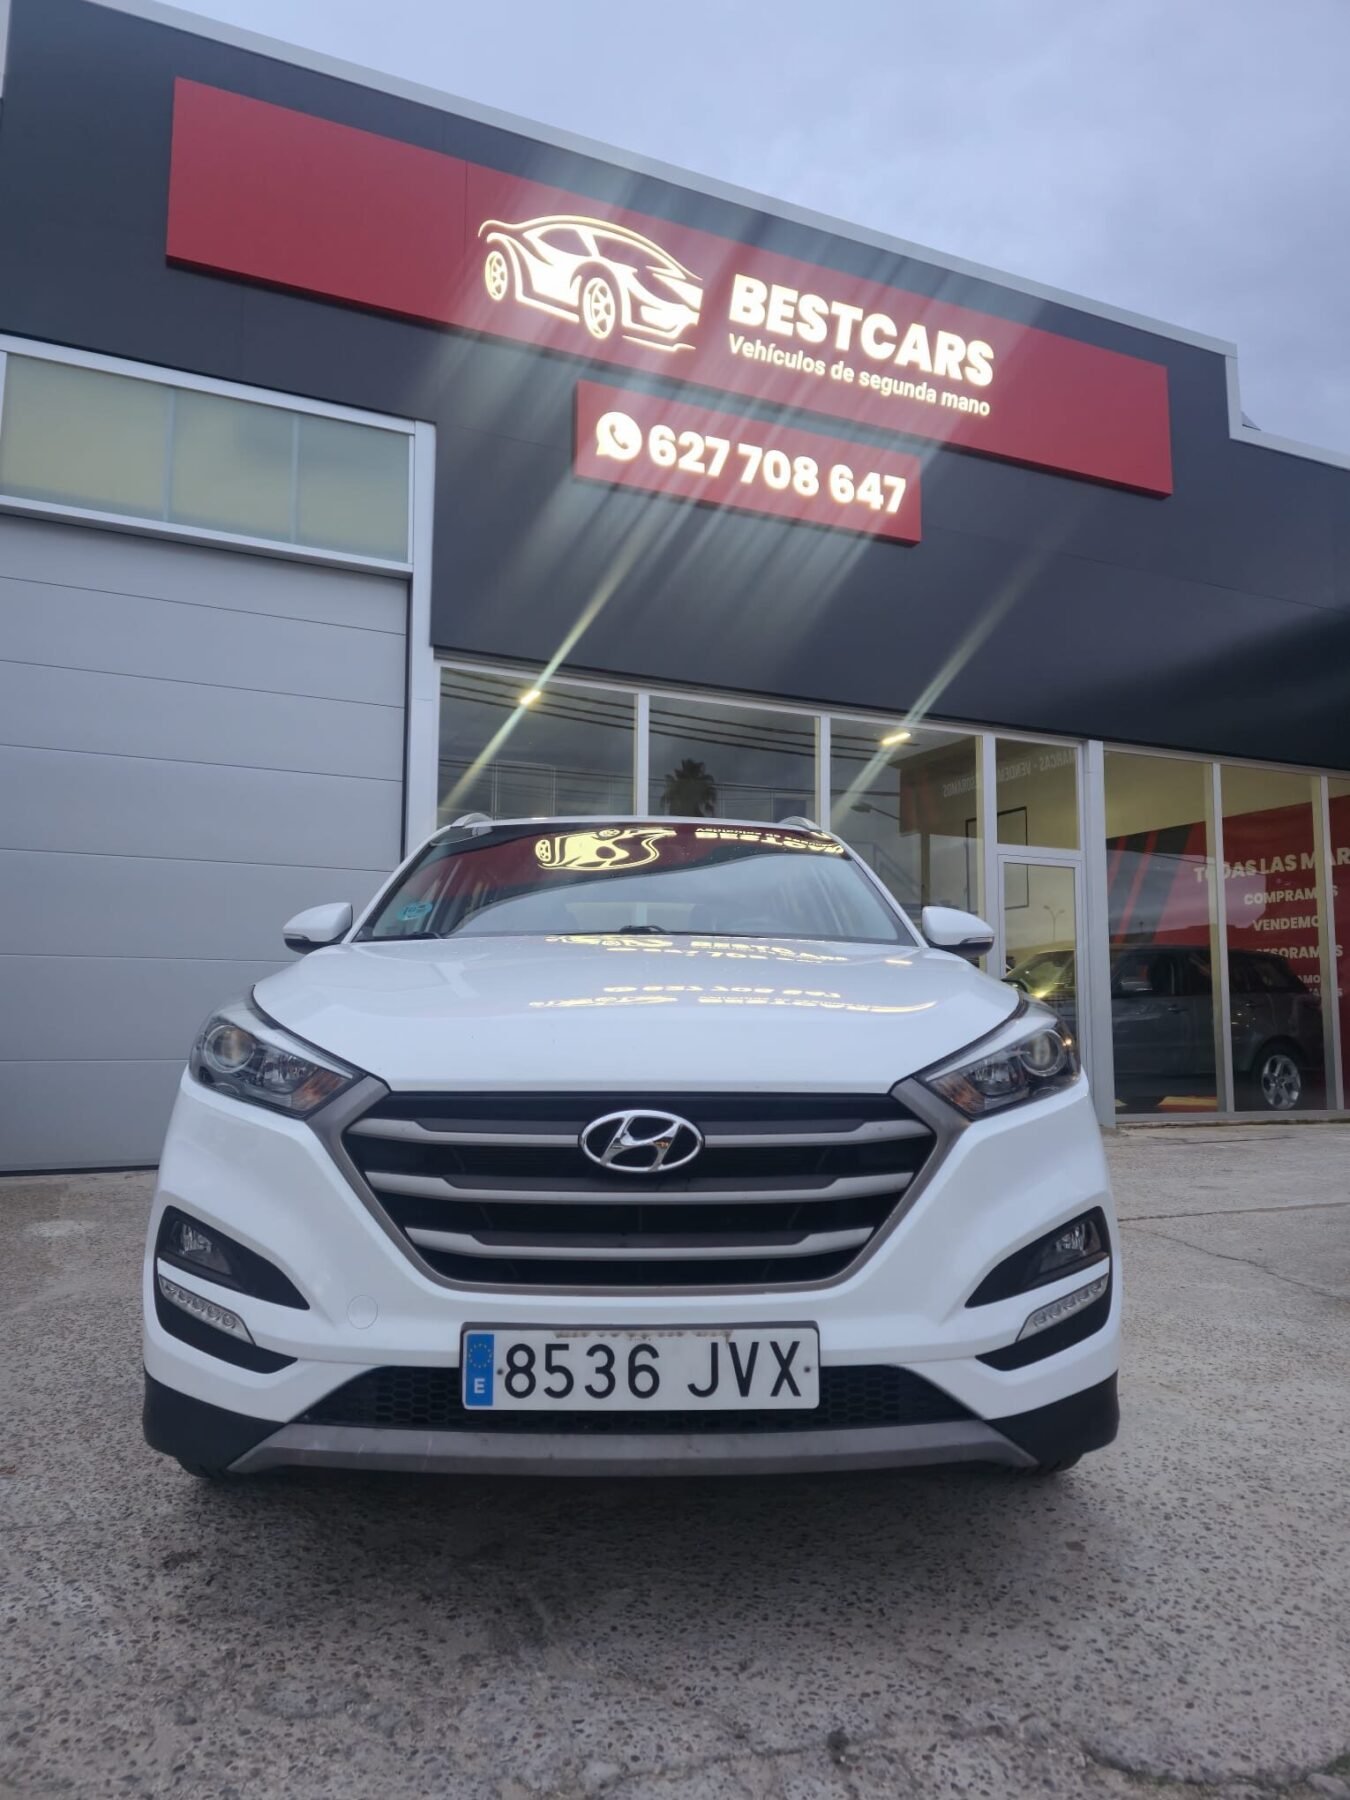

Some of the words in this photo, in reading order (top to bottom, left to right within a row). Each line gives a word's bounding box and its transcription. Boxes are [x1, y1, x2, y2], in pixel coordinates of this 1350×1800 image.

[729, 274, 994, 386] BESTCARS
[729, 333, 826, 375] Vehículos
[831, 361, 855, 382] de
[859, 370, 937, 403] segunda
[941, 391, 991, 416] mano
[649, 424, 730, 477] 627
[738, 443, 820, 496] 708
[829, 464, 907, 513] 647
[1260, 854, 1297, 874] LAS
[1244, 885, 1339, 905] COMPRAMS
[1252, 915, 1320, 931] VENDEMO
[474, 1378, 485, 1394] E
[504, 1343, 660, 1399] 8536
[687, 1341, 801, 1397] JVX
